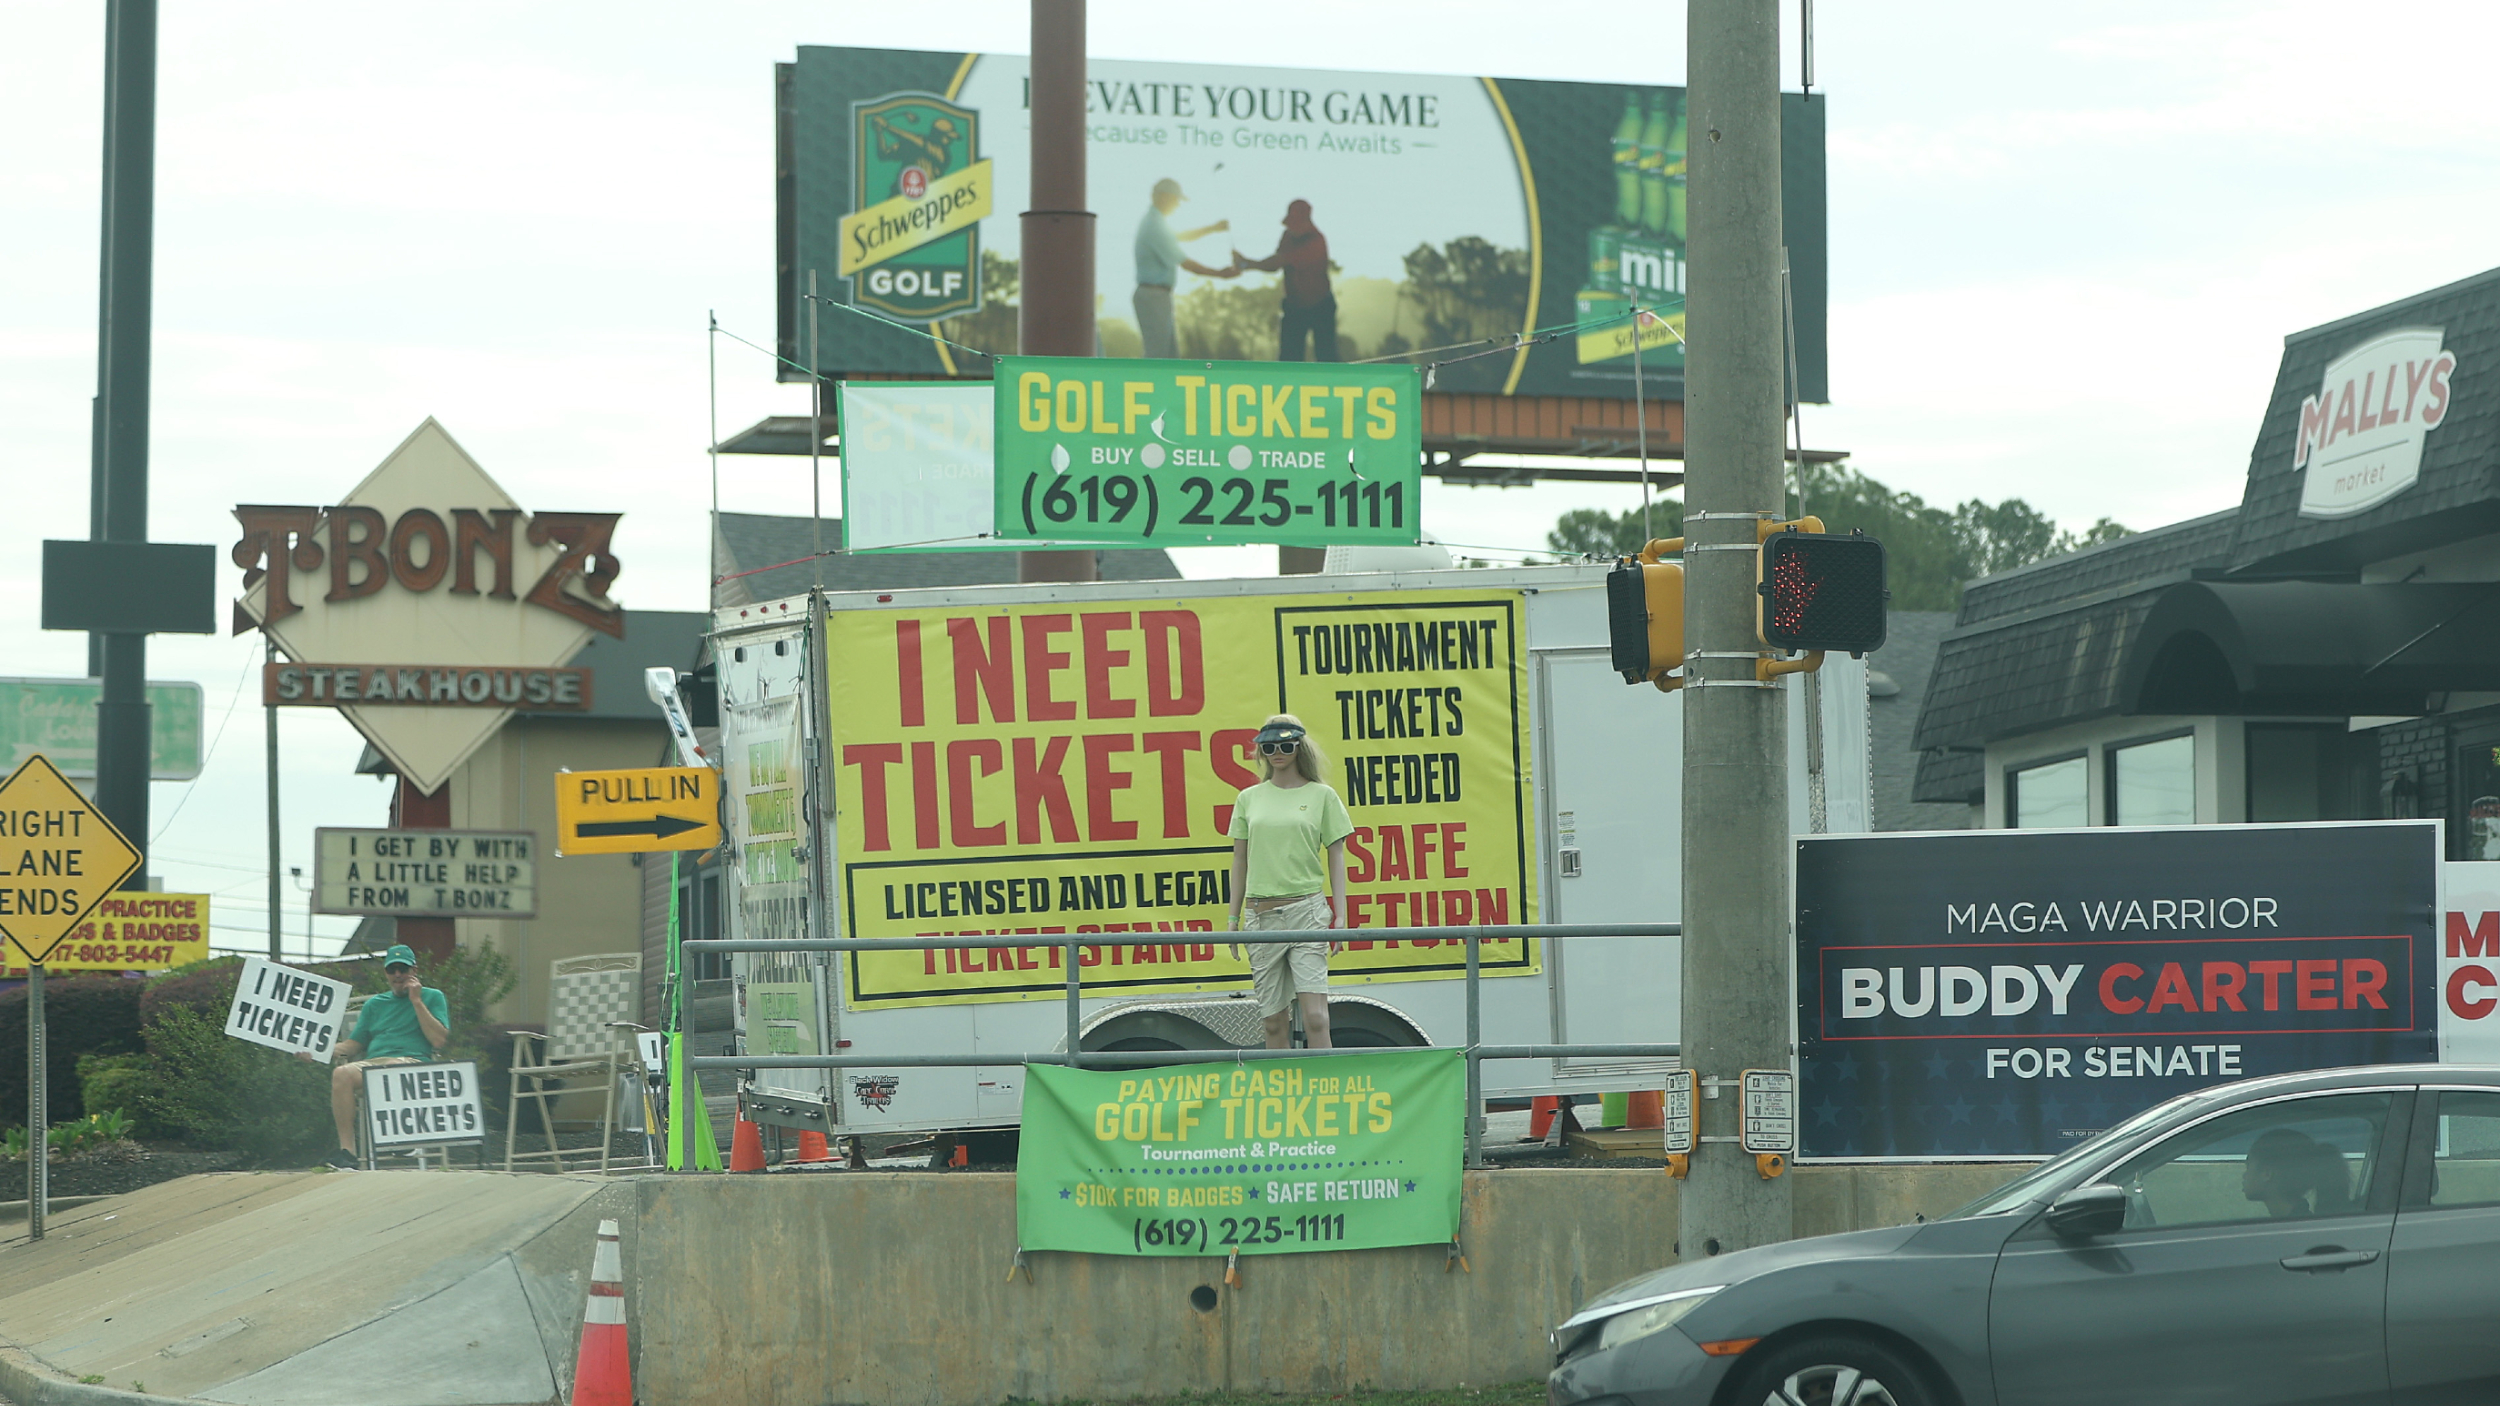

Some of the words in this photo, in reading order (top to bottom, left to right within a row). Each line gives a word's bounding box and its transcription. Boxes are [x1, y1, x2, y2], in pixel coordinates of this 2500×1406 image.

[1203, 84, 1314, 124] YOUR
[1323, 91, 1440, 129] GAME
[1085, 126, 1168, 145] ecause
[1177, 124, 1224, 147] The
[1232, 127, 1308, 152] Green
[1318, 131, 1402, 154] Awaits
[853, 180, 979, 264] Schweppes
[868, 268, 963, 297] GOLF
[1018, 371, 1155, 435] GOLF
[1175, 374, 1397, 441] TICKETS
[2297, 357, 2453, 465] MALLYS
[1091, 447, 1134, 465] BUY
[1172, 449, 1220, 467] SELL
[1259, 450, 1326, 469] TRADE
[2334, 463, 2386, 495] market
[1021, 472, 1159, 538] (619)
[1178, 477, 1403, 528] 225-1111
[1293, 619, 1497, 676] TOURNAMENT
[276, 667, 583, 703] STEAKHOUSE
[896, 619, 925, 727] I
[946, 609, 1205, 725] NEED
[1335, 686, 1463, 741] TICKETS
[582, 777, 661, 803] PULL
[671, 775, 699, 800] IN
[843, 728, 1263, 853] TICKETS
[1345, 752, 1461, 806] NEEDED
[351, 836, 357, 856] I
[375, 837, 415, 857] GET
[429, 838, 460, 858] BY
[474, 838, 526, 859] WITH
[1345, 822, 1469, 883] SAFE
[348, 862, 360, 880] A
[375, 863, 448, 883] LITTLE
[465, 864, 518, 884] HELP
[0, 888, 79, 916] ENDS
[101, 900, 197, 918] PRACTICE
[349, 887, 409, 908] FROM
[884, 877, 1050, 920] LICENSED
[1059, 873, 1127, 912] AND
[103, 922, 117, 941] &
[123, 922, 201, 942] BADGES
[1947, 901, 2069, 935] MAGA
[2081, 896, 2279, 931] WARRIOR
[46, 944, 175, 964] 17-803-5447
[915, 925, 1066, 975] TICKET
[1076, 919, 1215, 967] STAND
[254, 967, 267, 995] I
[271, 972, 335, 1014] NEED
[1841, 963, 2084, 1019] BUDDY
[2099, 957, 2389, 1014] CARTER
[237, 1001, 333, 1053] TICKETS
[1986, 1047, 2071, 1080] FOR
[2084, 1045, 2242, 1077] SENATE
[382, 1074, 391, 1102] I
[400, 1070, 463, 1101] NEED
[1118, 1074, 1220, 1102] PAYING
[1230, 1068, 1303, 1099] CASH
[1309, 1078, 1339, 1095] FOR
[1345, 1075, 1375, 1093] ALL
[376, 1103, 476, 1136] TICKETS
[1095, 1100, 1203, 1142] GOLF
[1220, 1092, 1392, 1139] TICKETS
[1141, 1144, 1246, 1160] Tournament
[1250, 1143, 1265, 1158] &
[1268, 1141, 1336, 1157] Practice
[1123, 1186, 1158, 1207] FOR
[1165, 1185, 1244, 1206] BADGES
[1267, 1180, 1318, 1203] SAFE
[1325, 1178, 1399, 1200] RETURN
[1134, 1218, 1208, 1252] (619)
[1219, 1213, 1345, 1245] 225-1111
